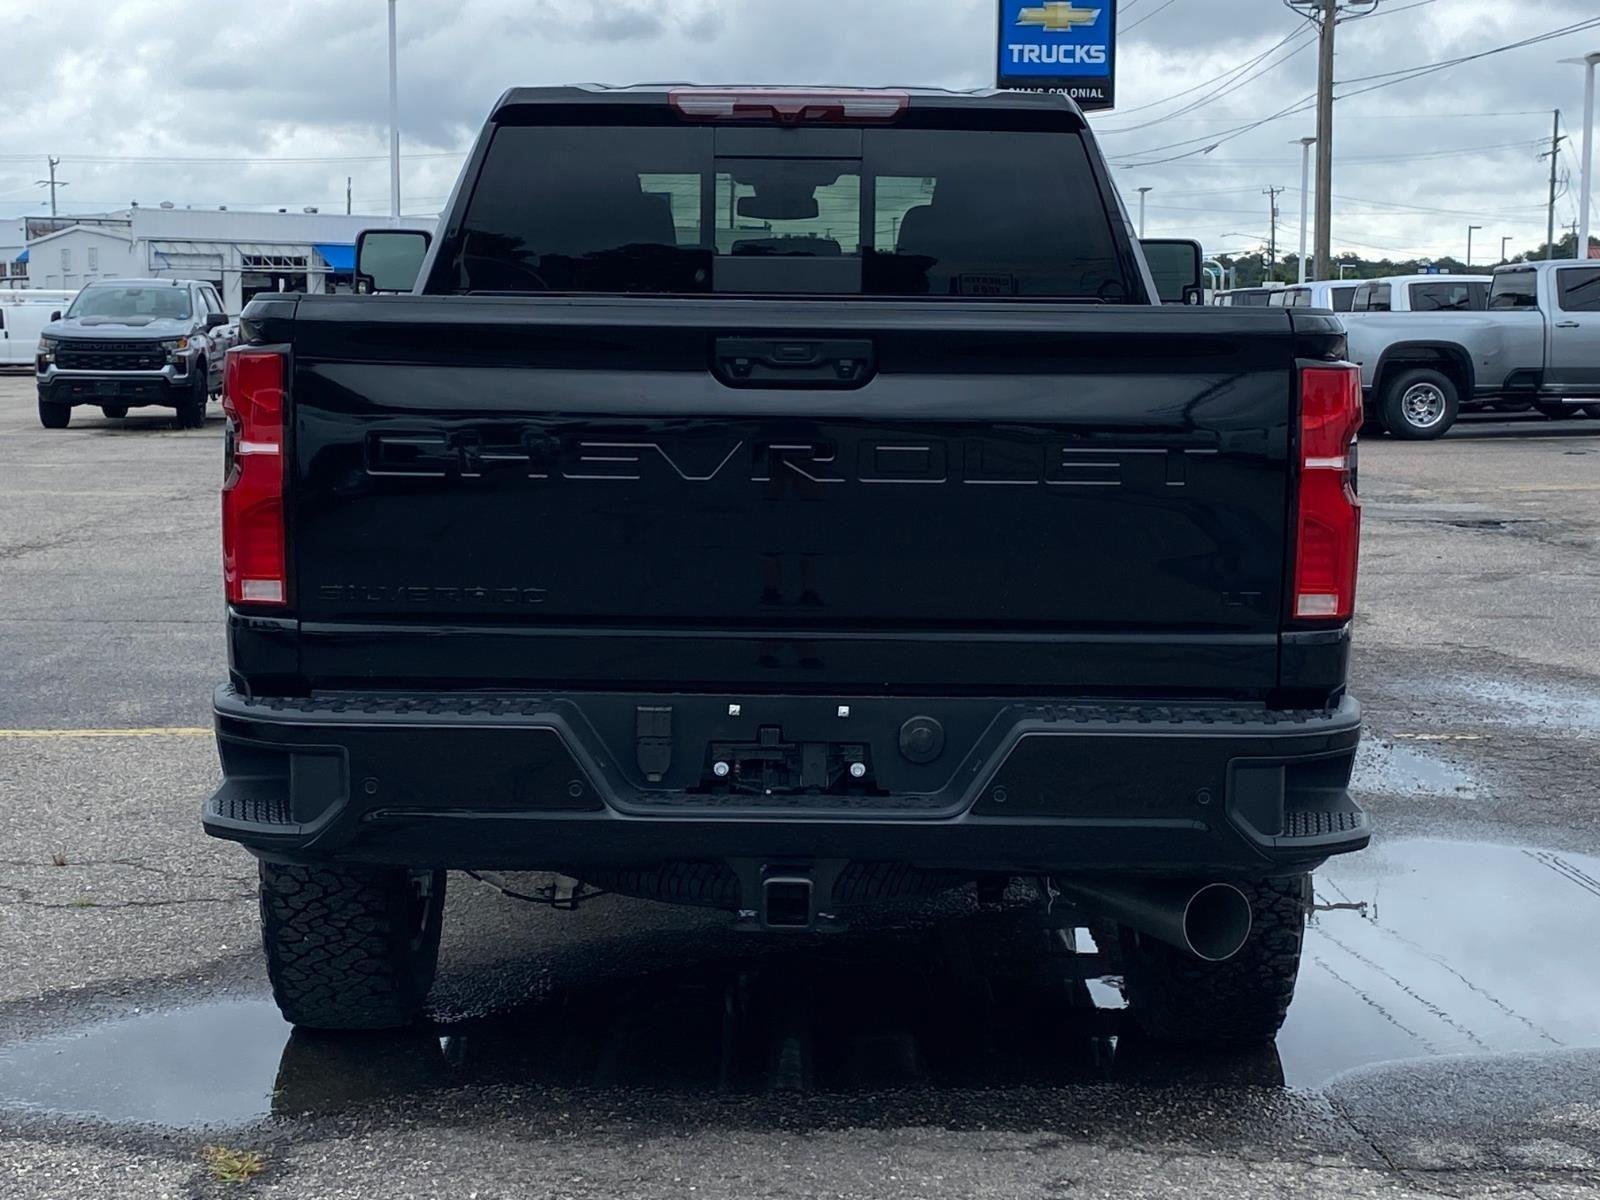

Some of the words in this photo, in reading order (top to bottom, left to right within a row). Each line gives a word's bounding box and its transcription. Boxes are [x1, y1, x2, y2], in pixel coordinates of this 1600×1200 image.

[1008, 44, 1106, 64] TRUCKS
[364, 431, 1219, 487] CHEVROLET
[318, 584, 549, 605] SILVERADO
